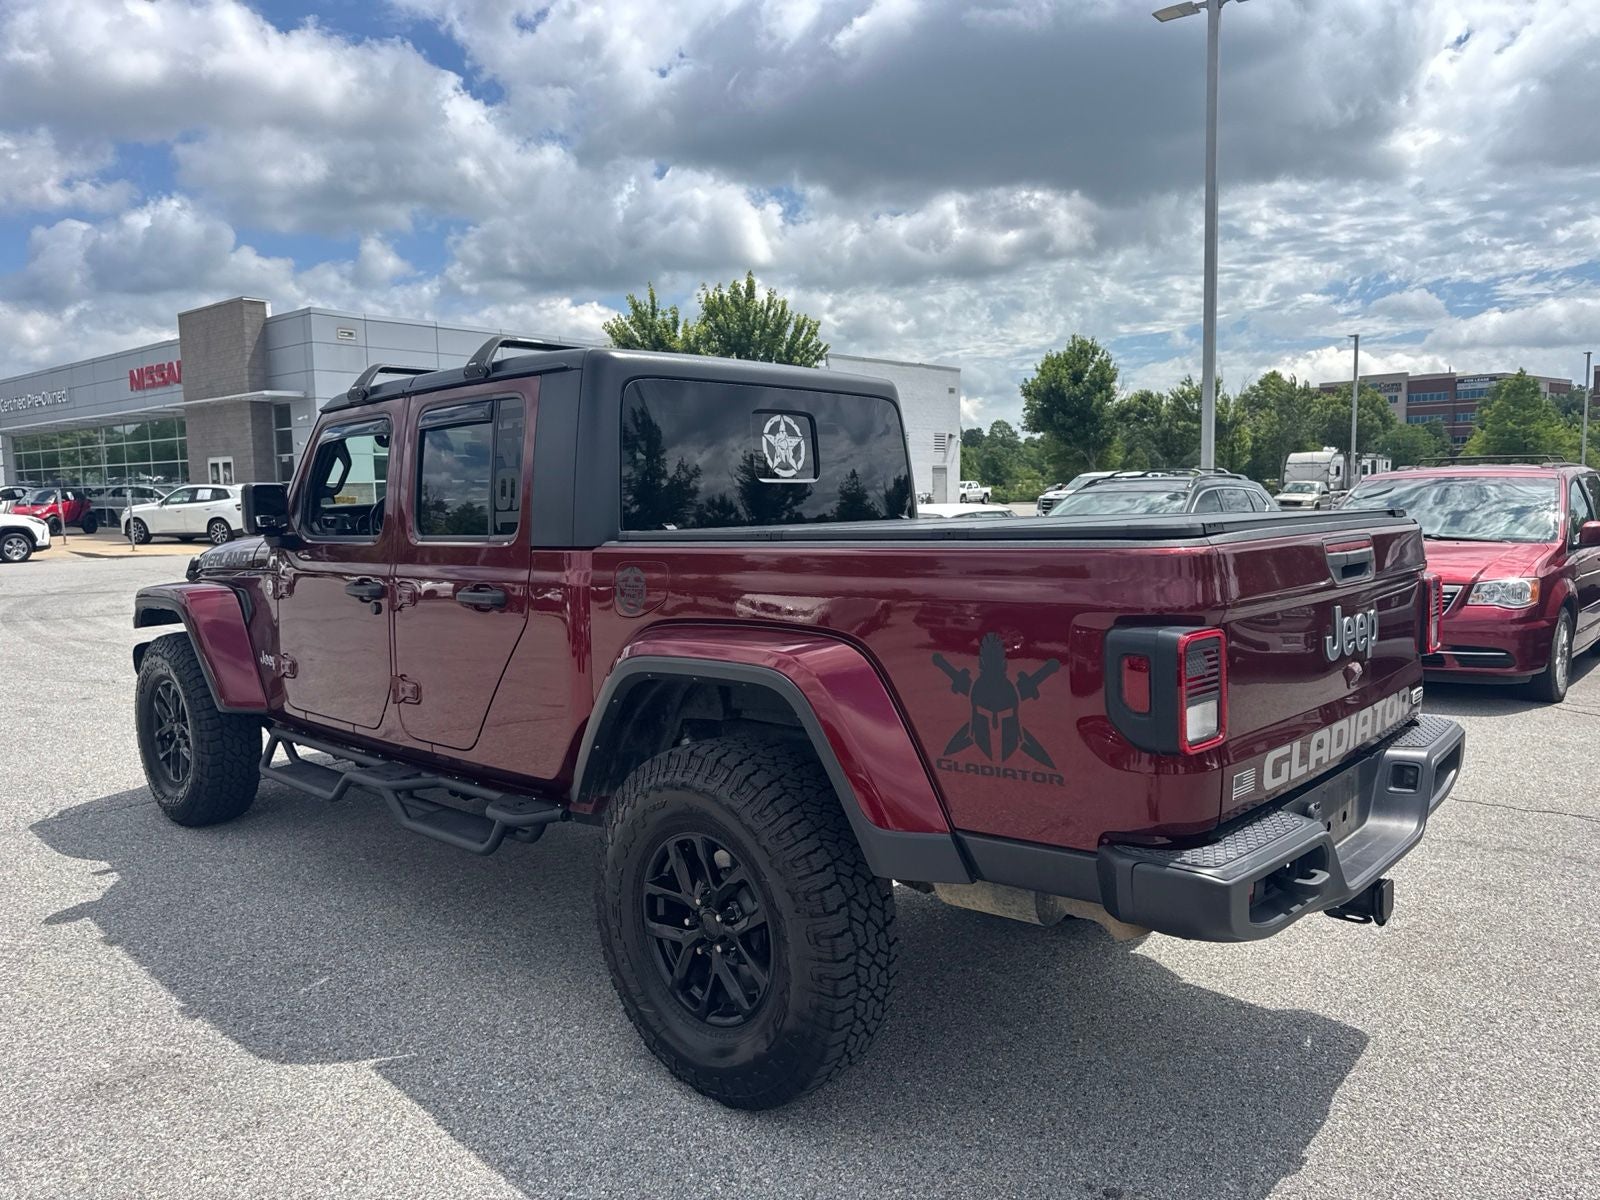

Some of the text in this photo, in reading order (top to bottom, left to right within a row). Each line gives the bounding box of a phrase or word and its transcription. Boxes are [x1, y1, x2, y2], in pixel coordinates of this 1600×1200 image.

[1324, 605, 1378, 661] Jeep
[260, 650, 275, 670] Jeep
[1263, 686, 1410, 791] GLADIATOR
[936, 758, 1065, 787] GLADIATOR
